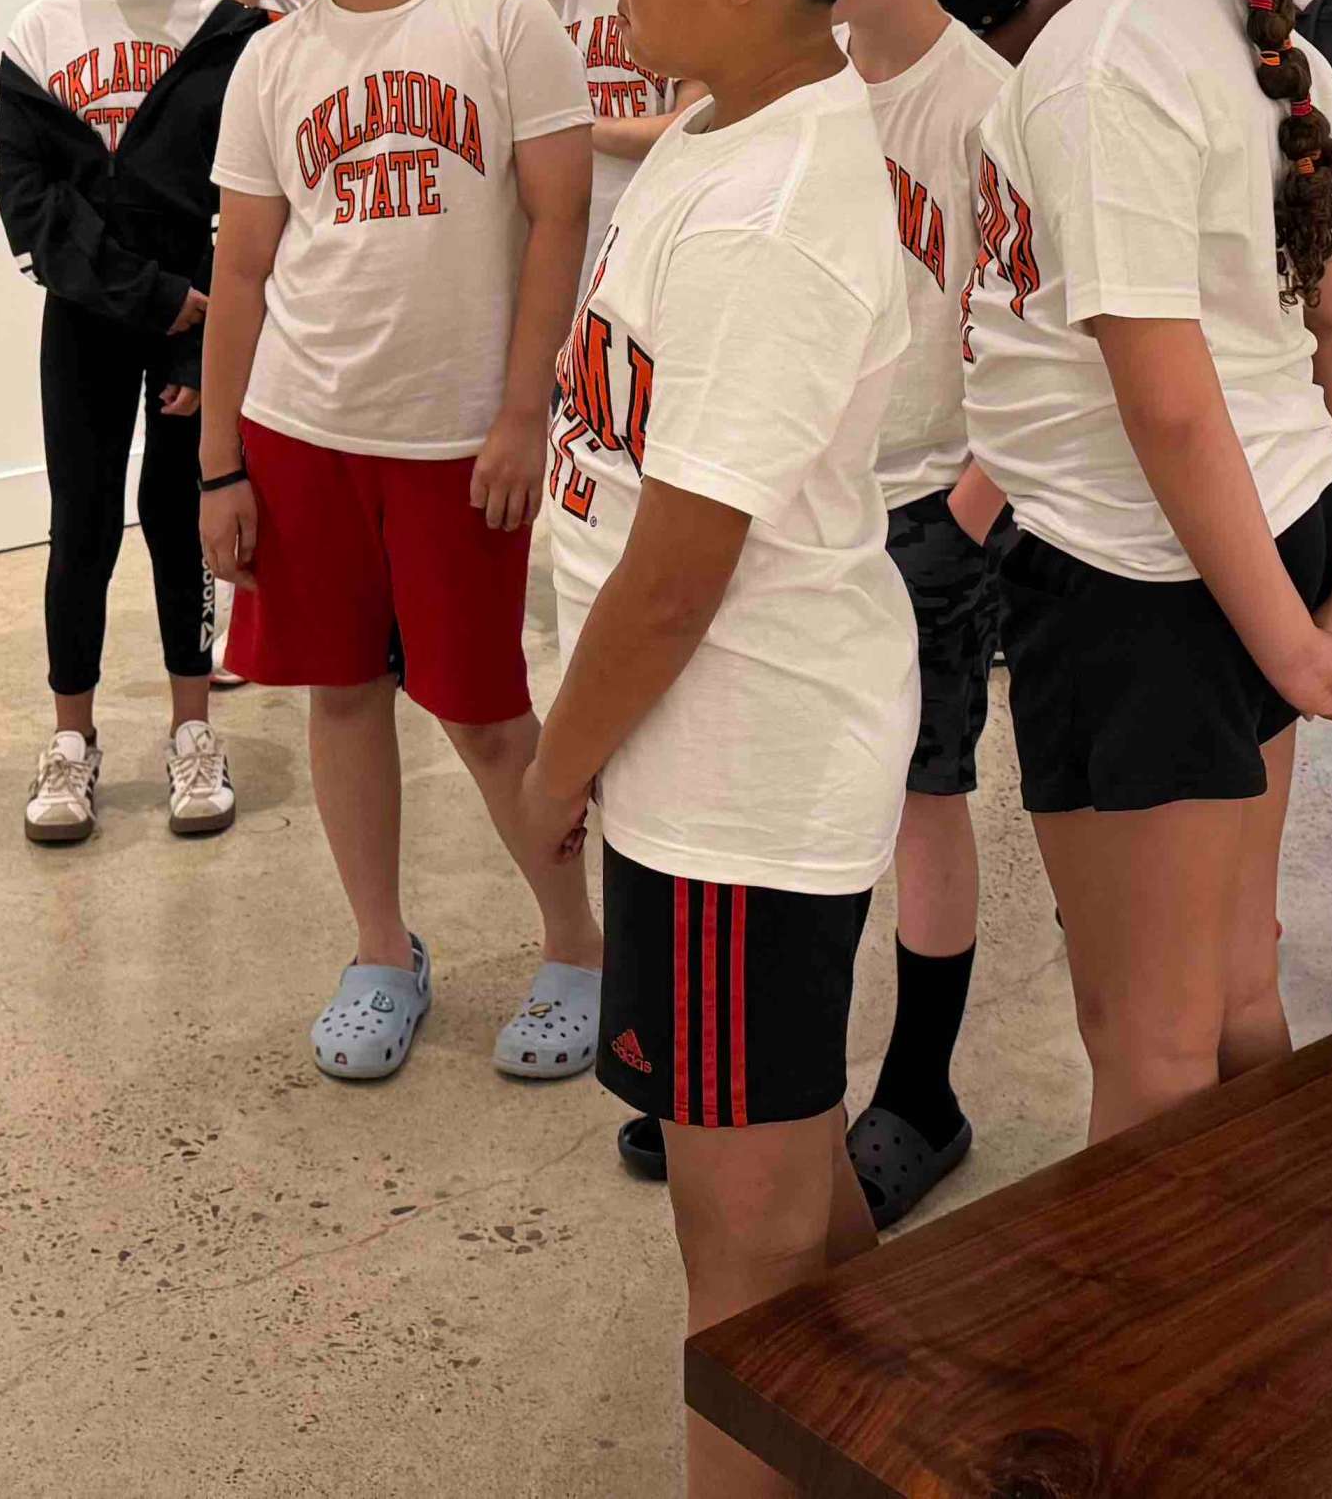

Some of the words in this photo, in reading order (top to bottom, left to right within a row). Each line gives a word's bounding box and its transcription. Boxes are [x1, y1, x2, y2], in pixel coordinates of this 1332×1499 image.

[48, 41, 184, 113] OKLAHO
[587, 80, 647, 118] ATE
[296, 70, 485, 189] OKLAHOMA
[333, 148, 441, 225] STATE
